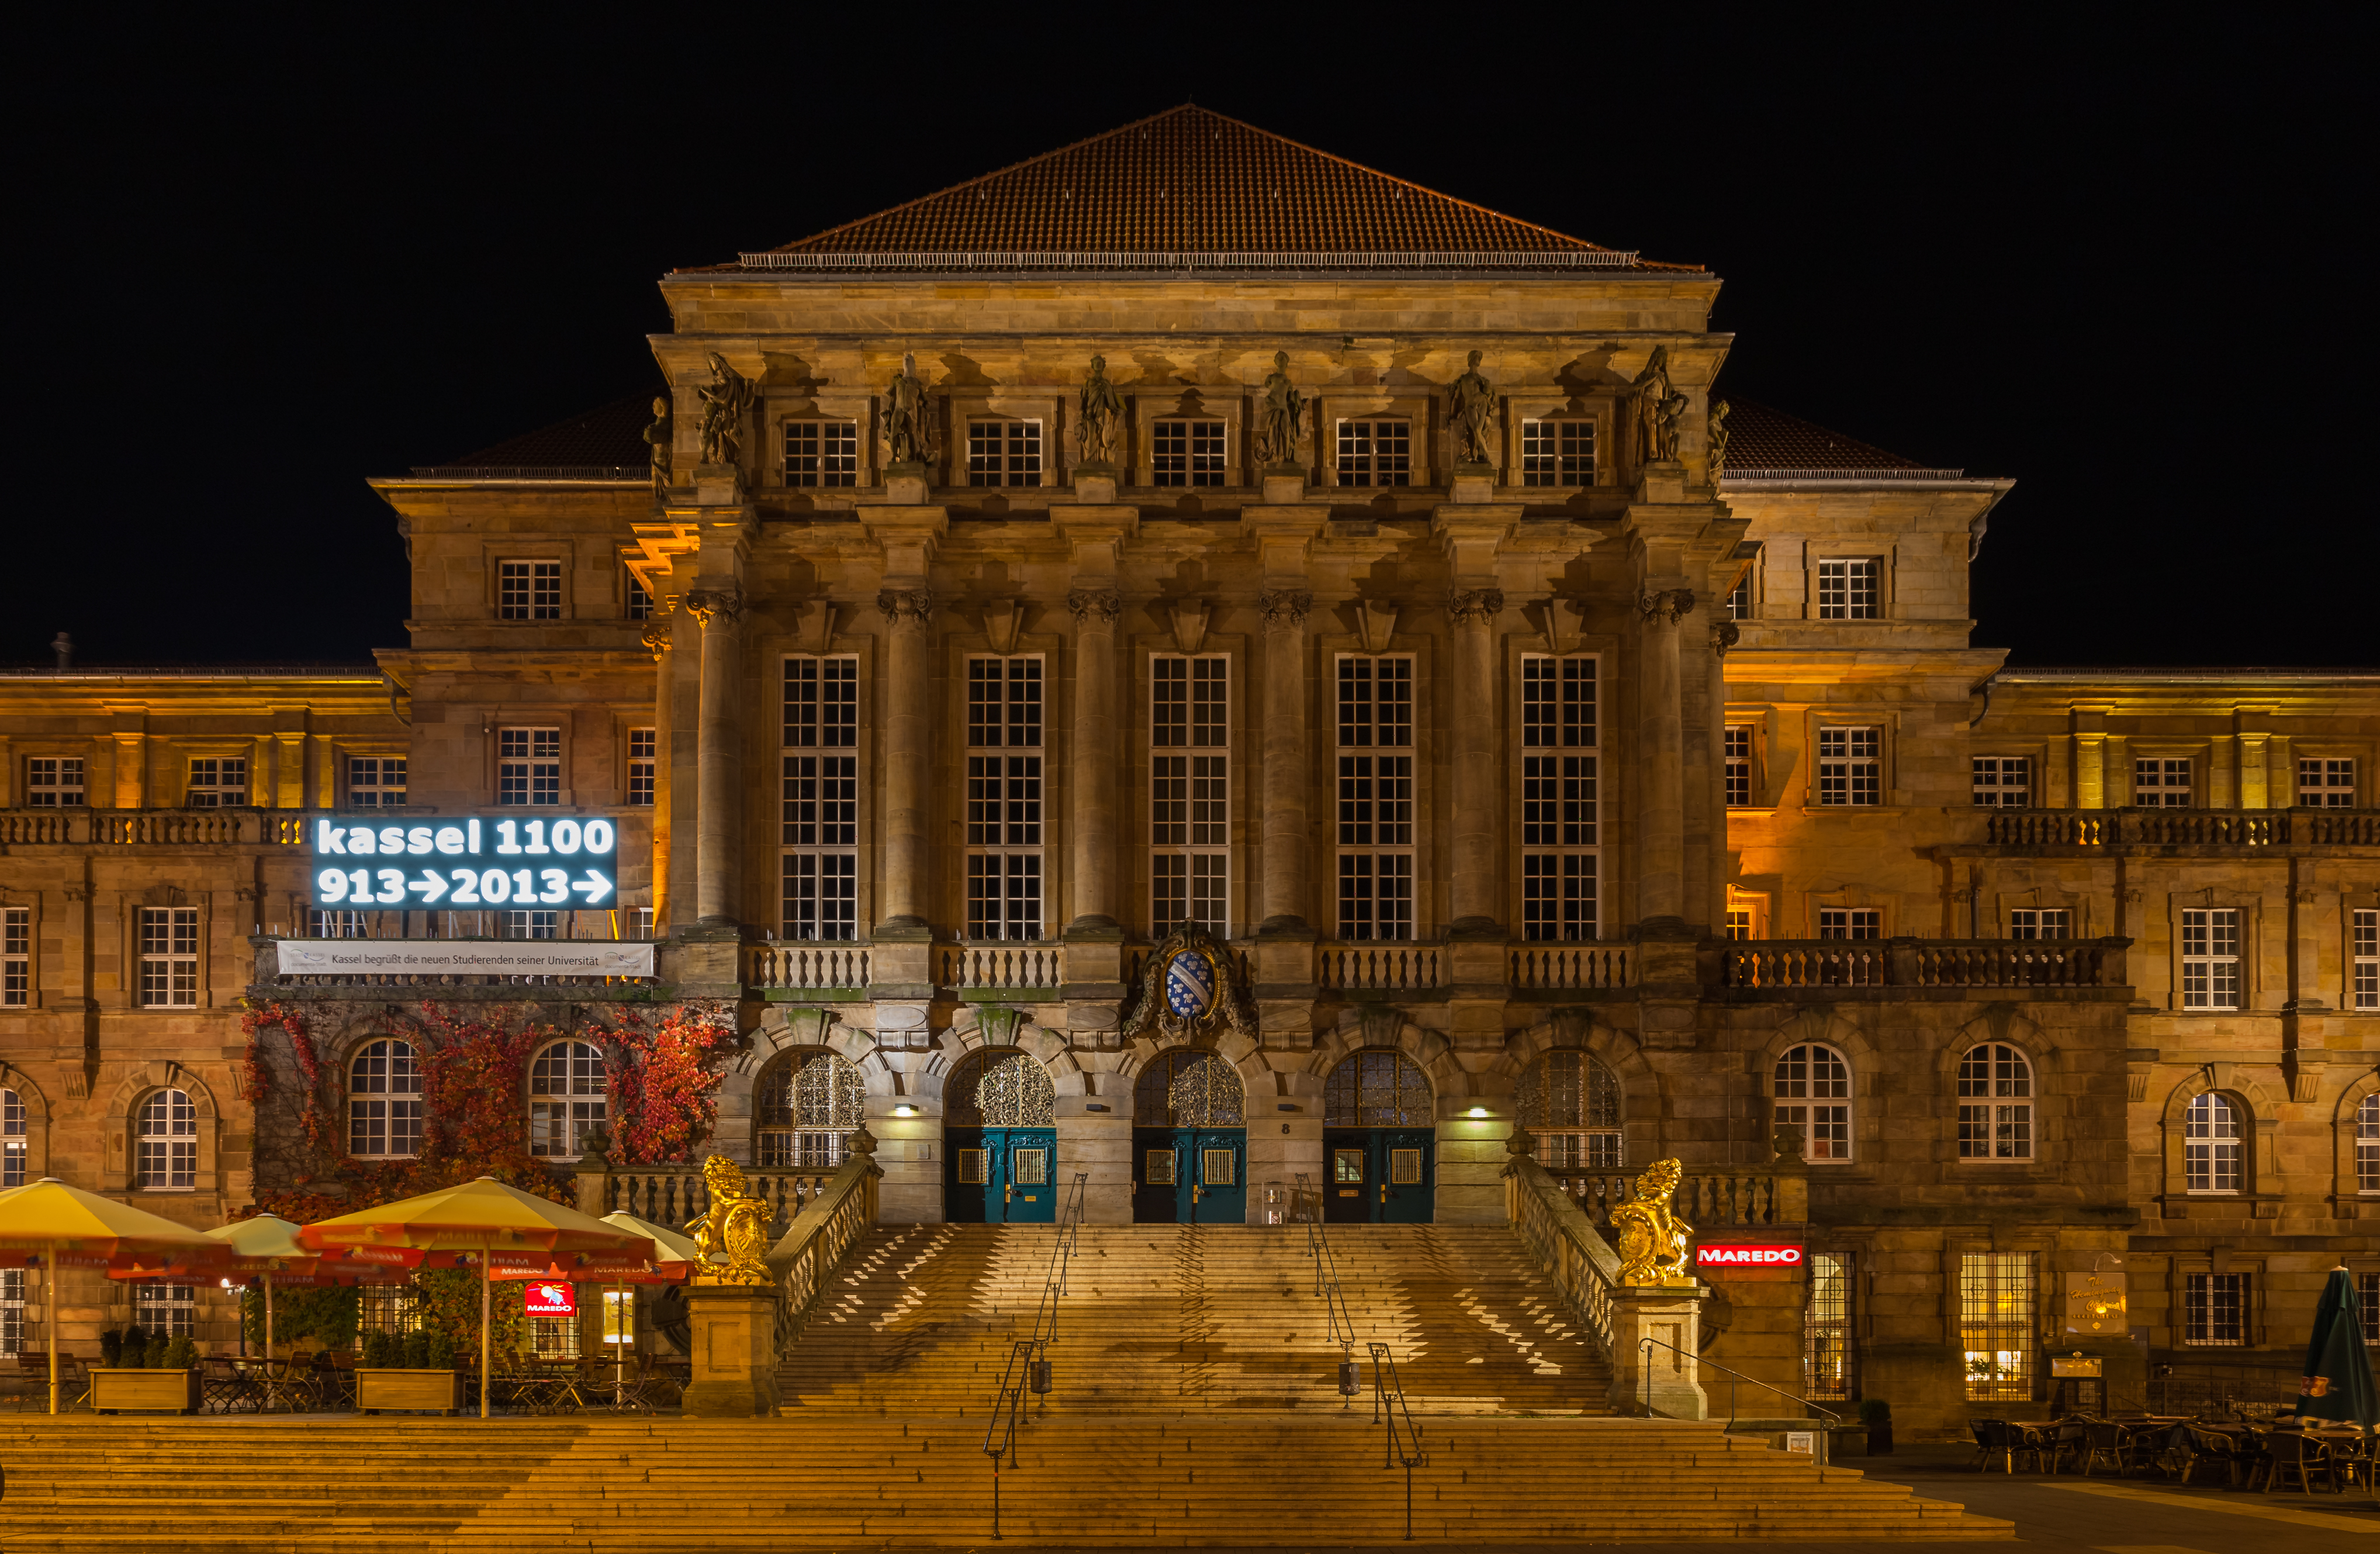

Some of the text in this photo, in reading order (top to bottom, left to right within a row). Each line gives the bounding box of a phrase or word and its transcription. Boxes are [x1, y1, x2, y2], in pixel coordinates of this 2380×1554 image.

[318, 819, 614, 854] kassel 1100
[317, 868, 570, 903] 913 2013
[332, 954, 362, 964] Kassel
[364, 954, 402, 966] begrüßt
[404, 954, 418, 964] die
[452, 954, 514, 965] Studierenden
[517, 955, 545, 965] seiner
[548, 955, 600, 966] Universität
[1281, 1123, 1291, 1135] 8
[1698, 1249, 1801, 1262] MAREDO
[2087, 1277, 2104, 1287] The
[2070, 1287, 2122, 1299] Hemingway
